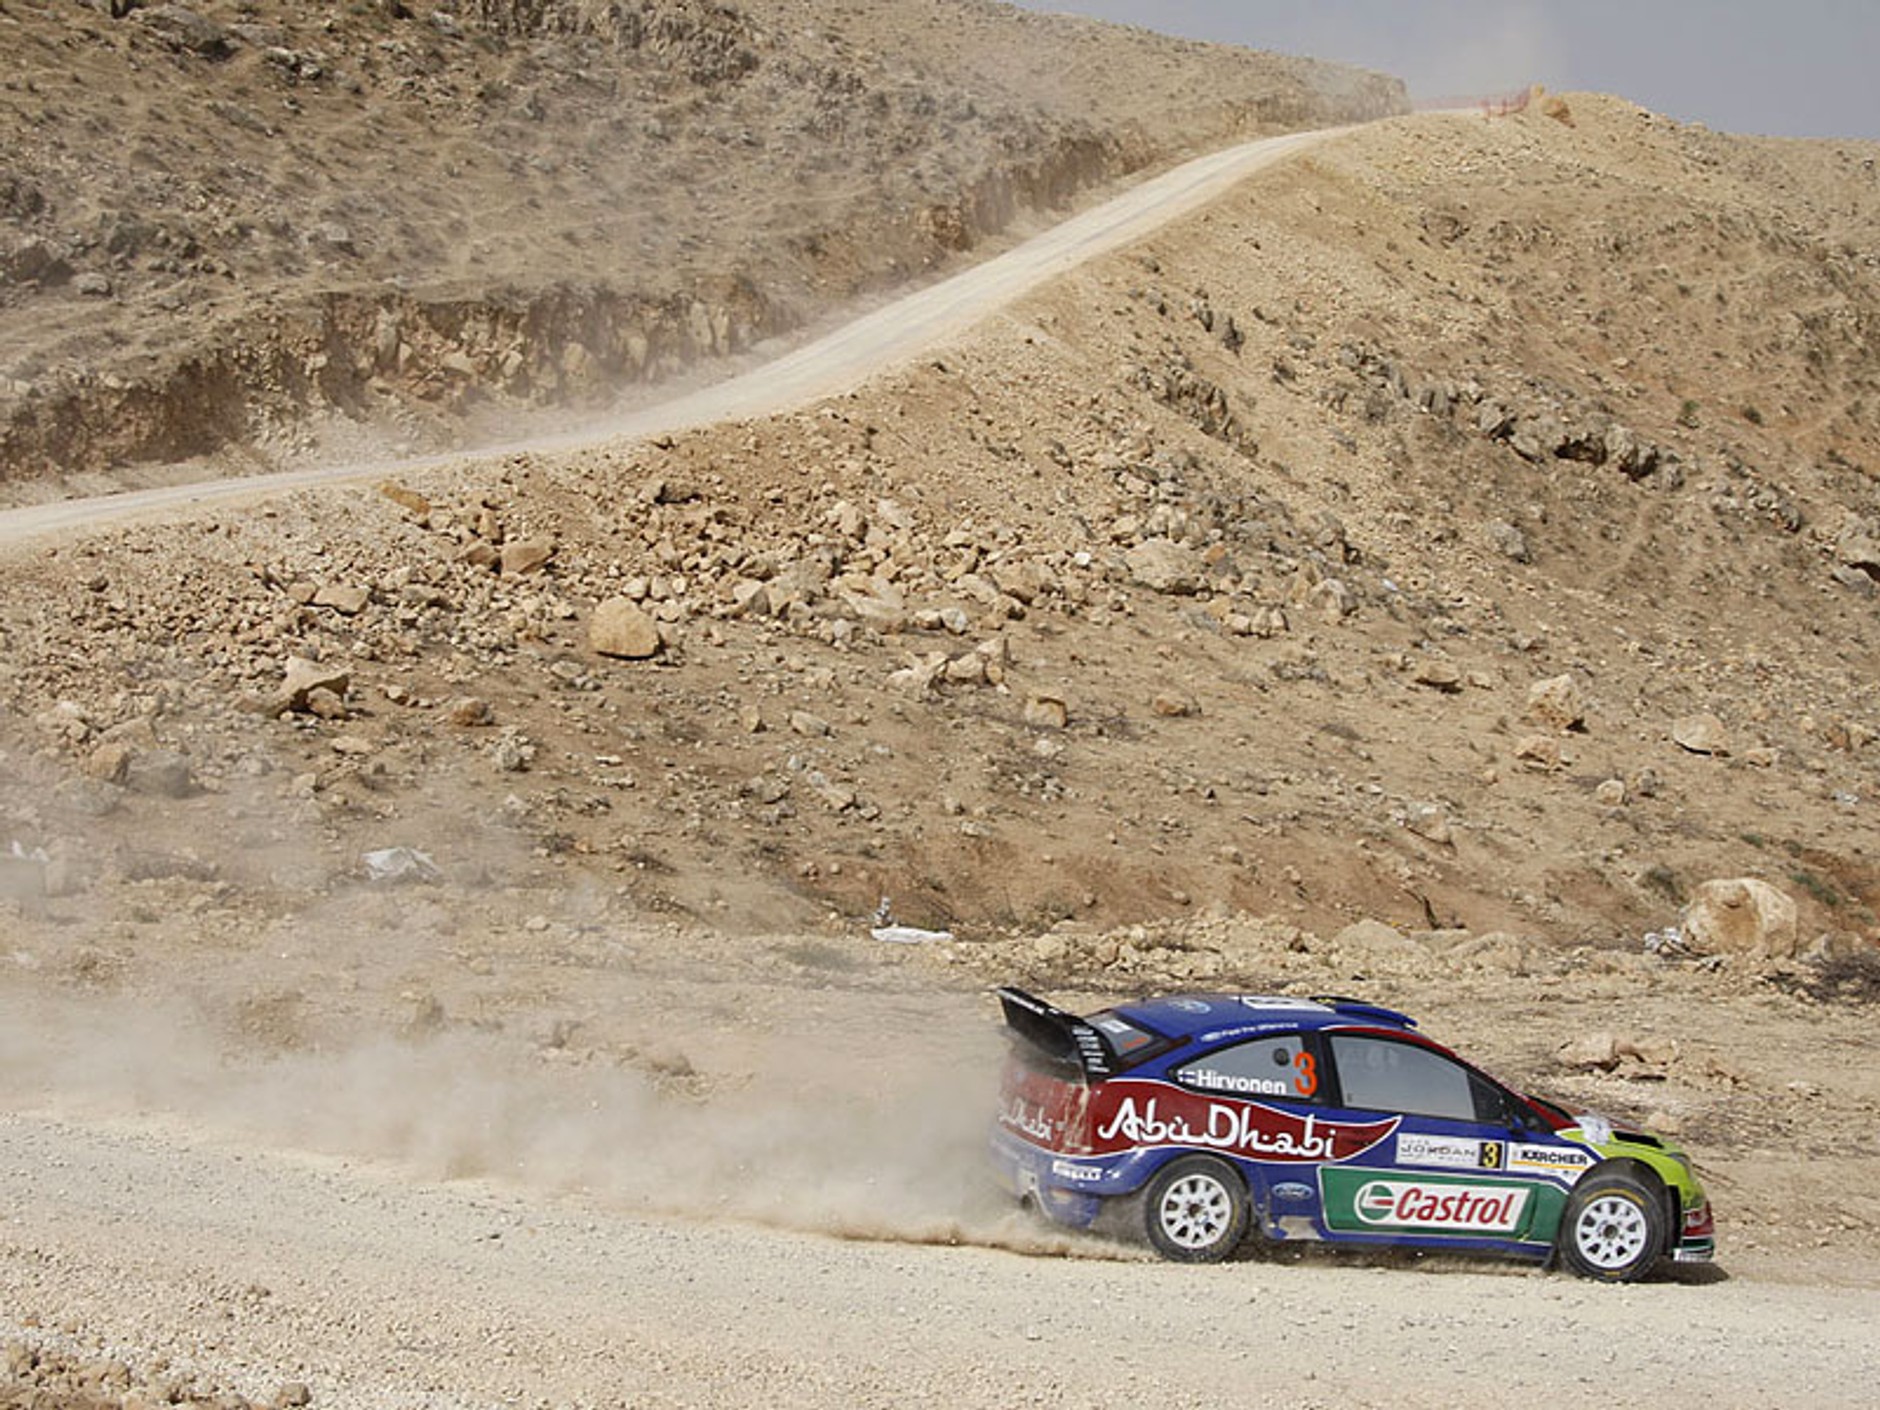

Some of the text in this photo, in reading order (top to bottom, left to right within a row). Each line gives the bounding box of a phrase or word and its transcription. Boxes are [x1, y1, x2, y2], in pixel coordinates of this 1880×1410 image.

[1197, 1069, 1287, 1095] Hirvonen
[1294, 1052, 1318, 1096] 3
[1201, 1103, 1336, 1158] Dhabi
[1483, 1142, 1498, 1168] 3
[1395, 1187, 1515, 1225] Castrol
